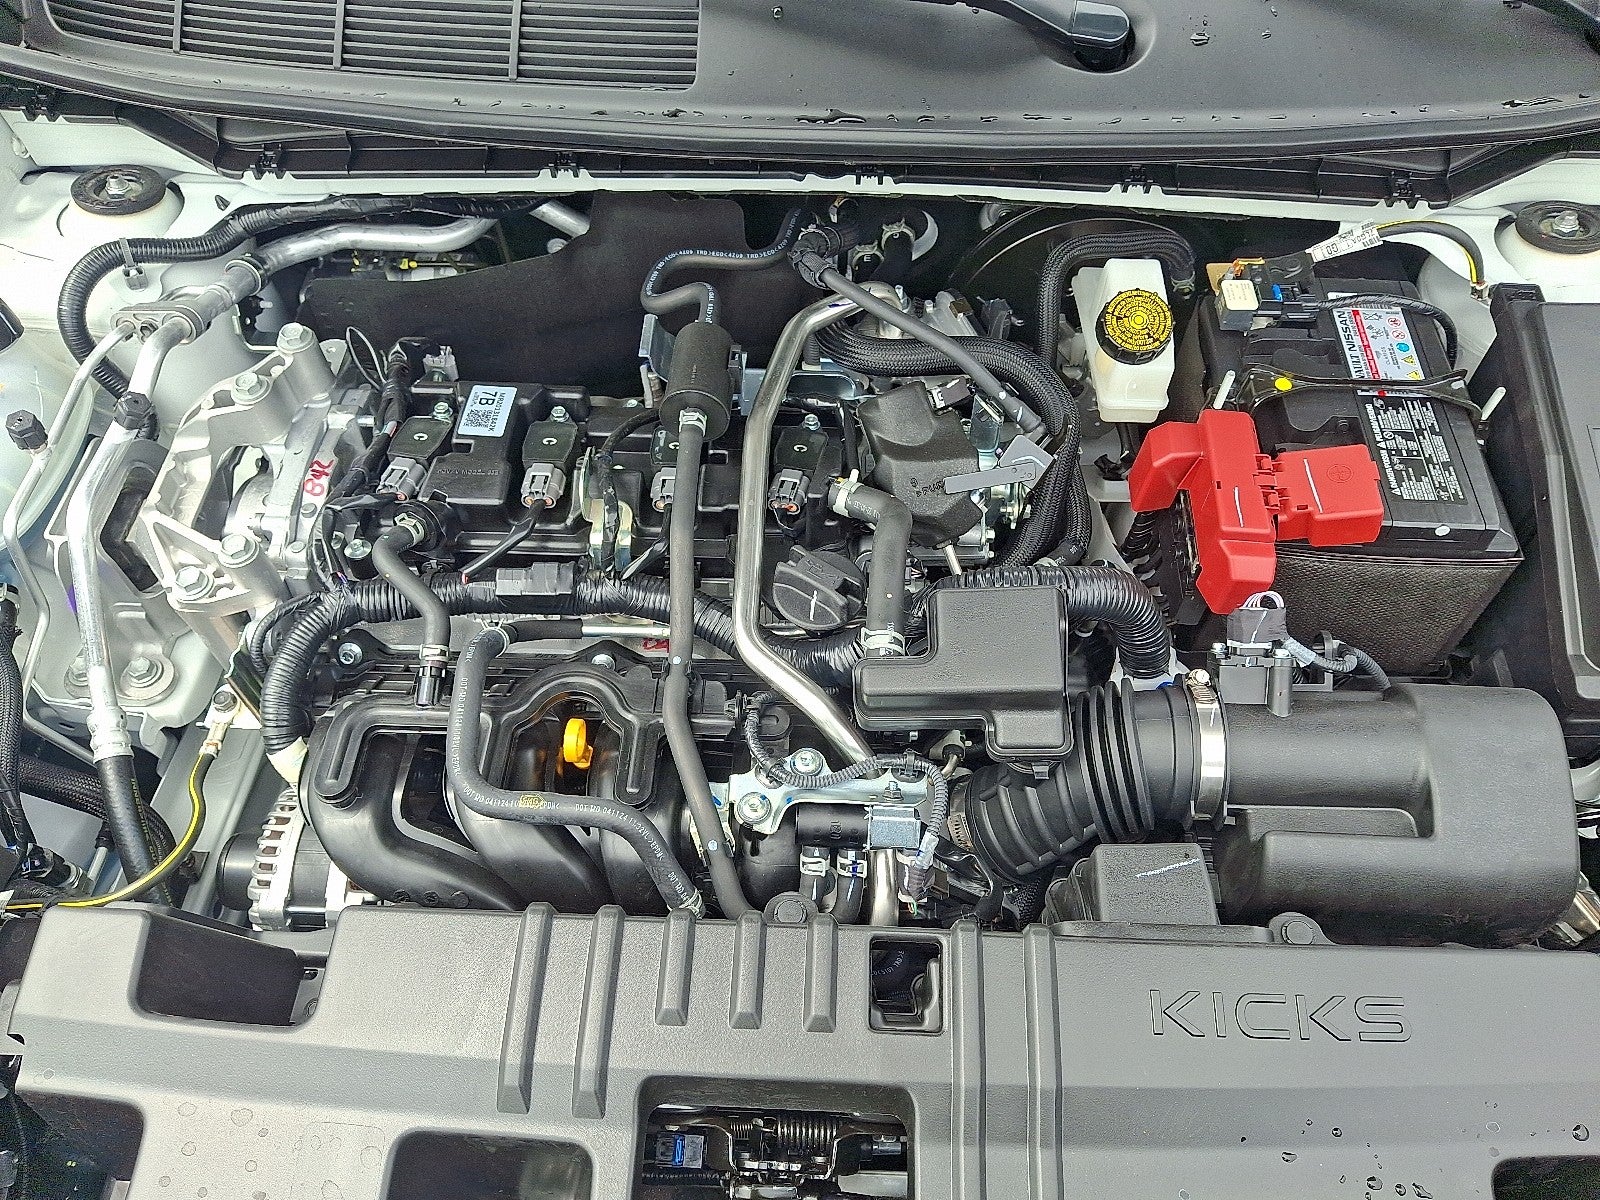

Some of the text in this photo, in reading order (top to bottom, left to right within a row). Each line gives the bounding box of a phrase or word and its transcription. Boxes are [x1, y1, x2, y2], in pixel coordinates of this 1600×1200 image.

[863, 254, 872, 262] E
[1337, 310, 1358, 352] NISSAN
[479, 391, 498, 406] 7B
[1149, 989, 1412, 1042] KICKS
